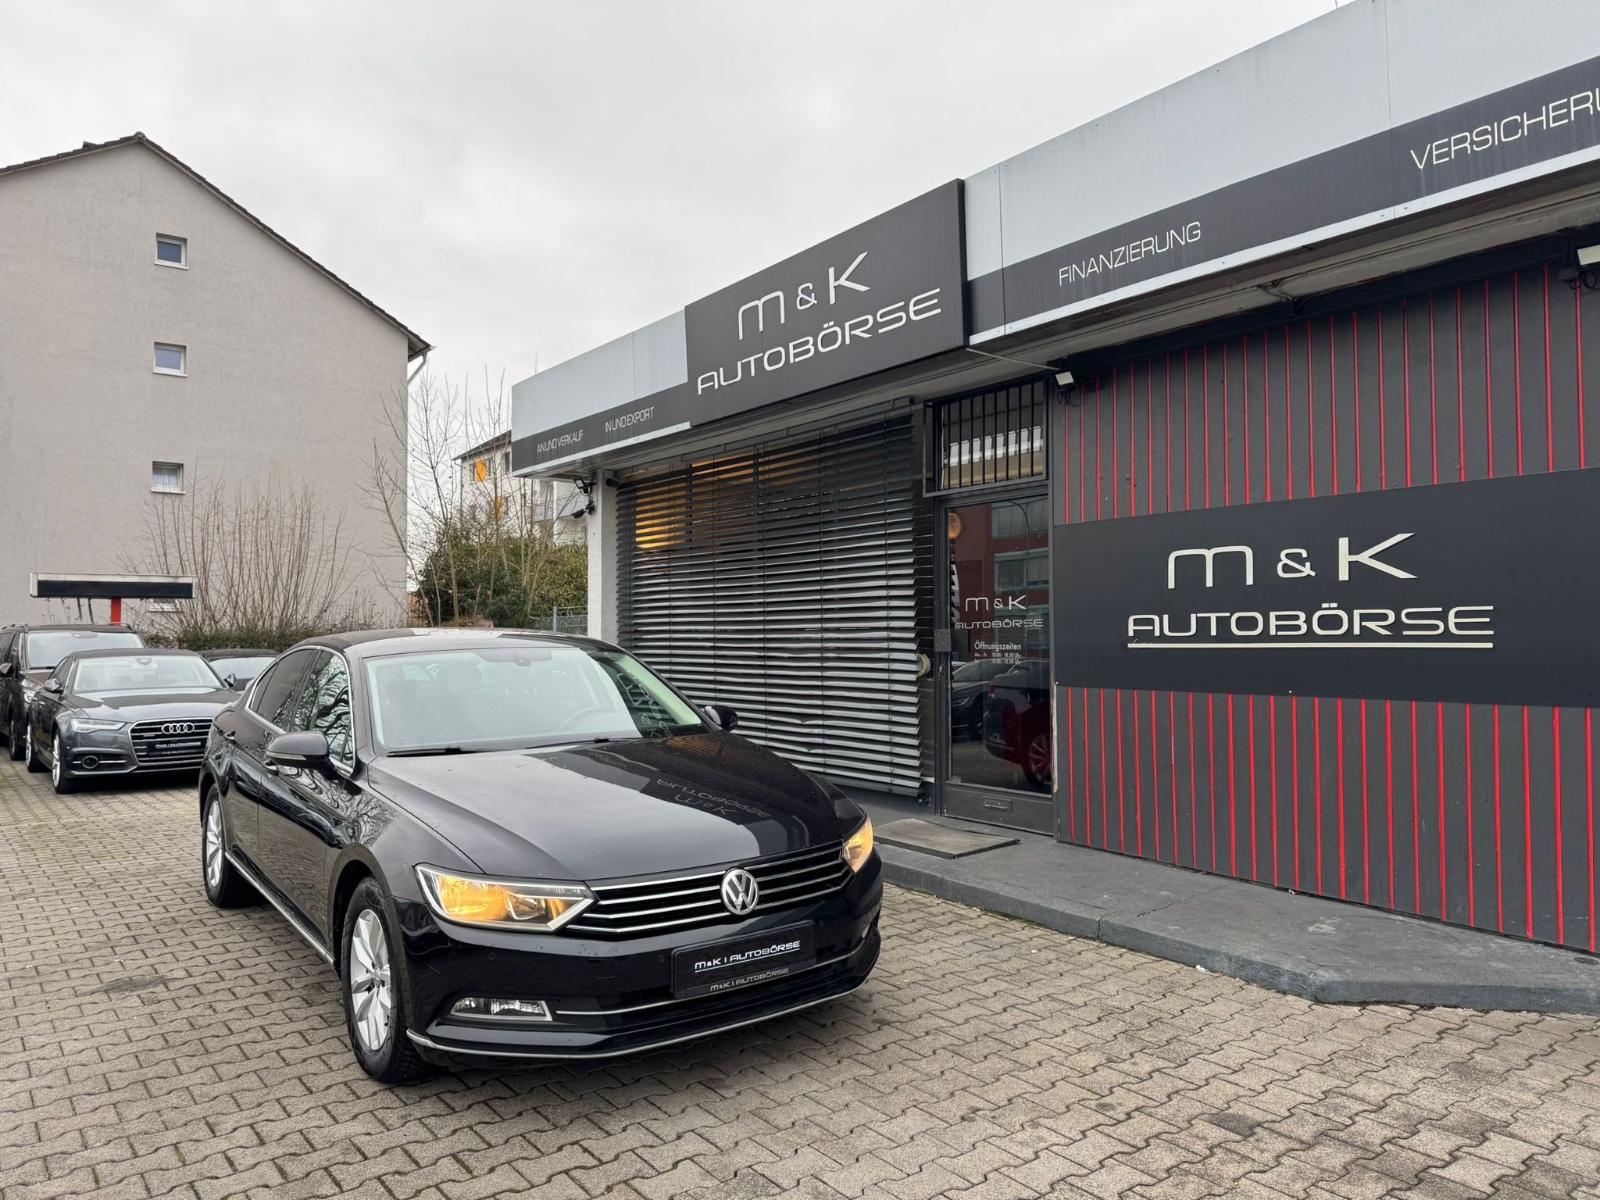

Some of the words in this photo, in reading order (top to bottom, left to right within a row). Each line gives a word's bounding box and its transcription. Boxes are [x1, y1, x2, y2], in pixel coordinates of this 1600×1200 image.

[1410, 88, 1600, 169] VERSICHER
[1058, 221, 1201, 287] FINANZIERUNG
[738, 290, 785, 341] M
[796, 282, 818, 311] &
[828, 251, 871, 305] K
[697, 287, 942, 396] AUTOBÖRSE
[604, 420, 612, 433] IN
[612, 415, 627, 431] UND
[627, 406, 655, 427] EXPORT
[545, 439, 557, 451] UND
[557, 429, 585, 448] VERKAUF
[1167, 545, 1254, 590] M
[1277, 548, 1316, 578] &
[1338, 532, 1419, 581] K
[965, 596, 989, 612] M
[993, 598, 1004, 609] &
[1008, 594, 1027, 611] K
[954, 618, 1044, 630] AUTOBÖRSE
[1127, 602, 1495, 637] AUTOBÖRSE
[974, 640, 1022, 652] Öffnungszeiten
[729, 940, 801, 962] AUTOBÖRSE
[735, 967, 790, 985] AUTOBÖRSE
